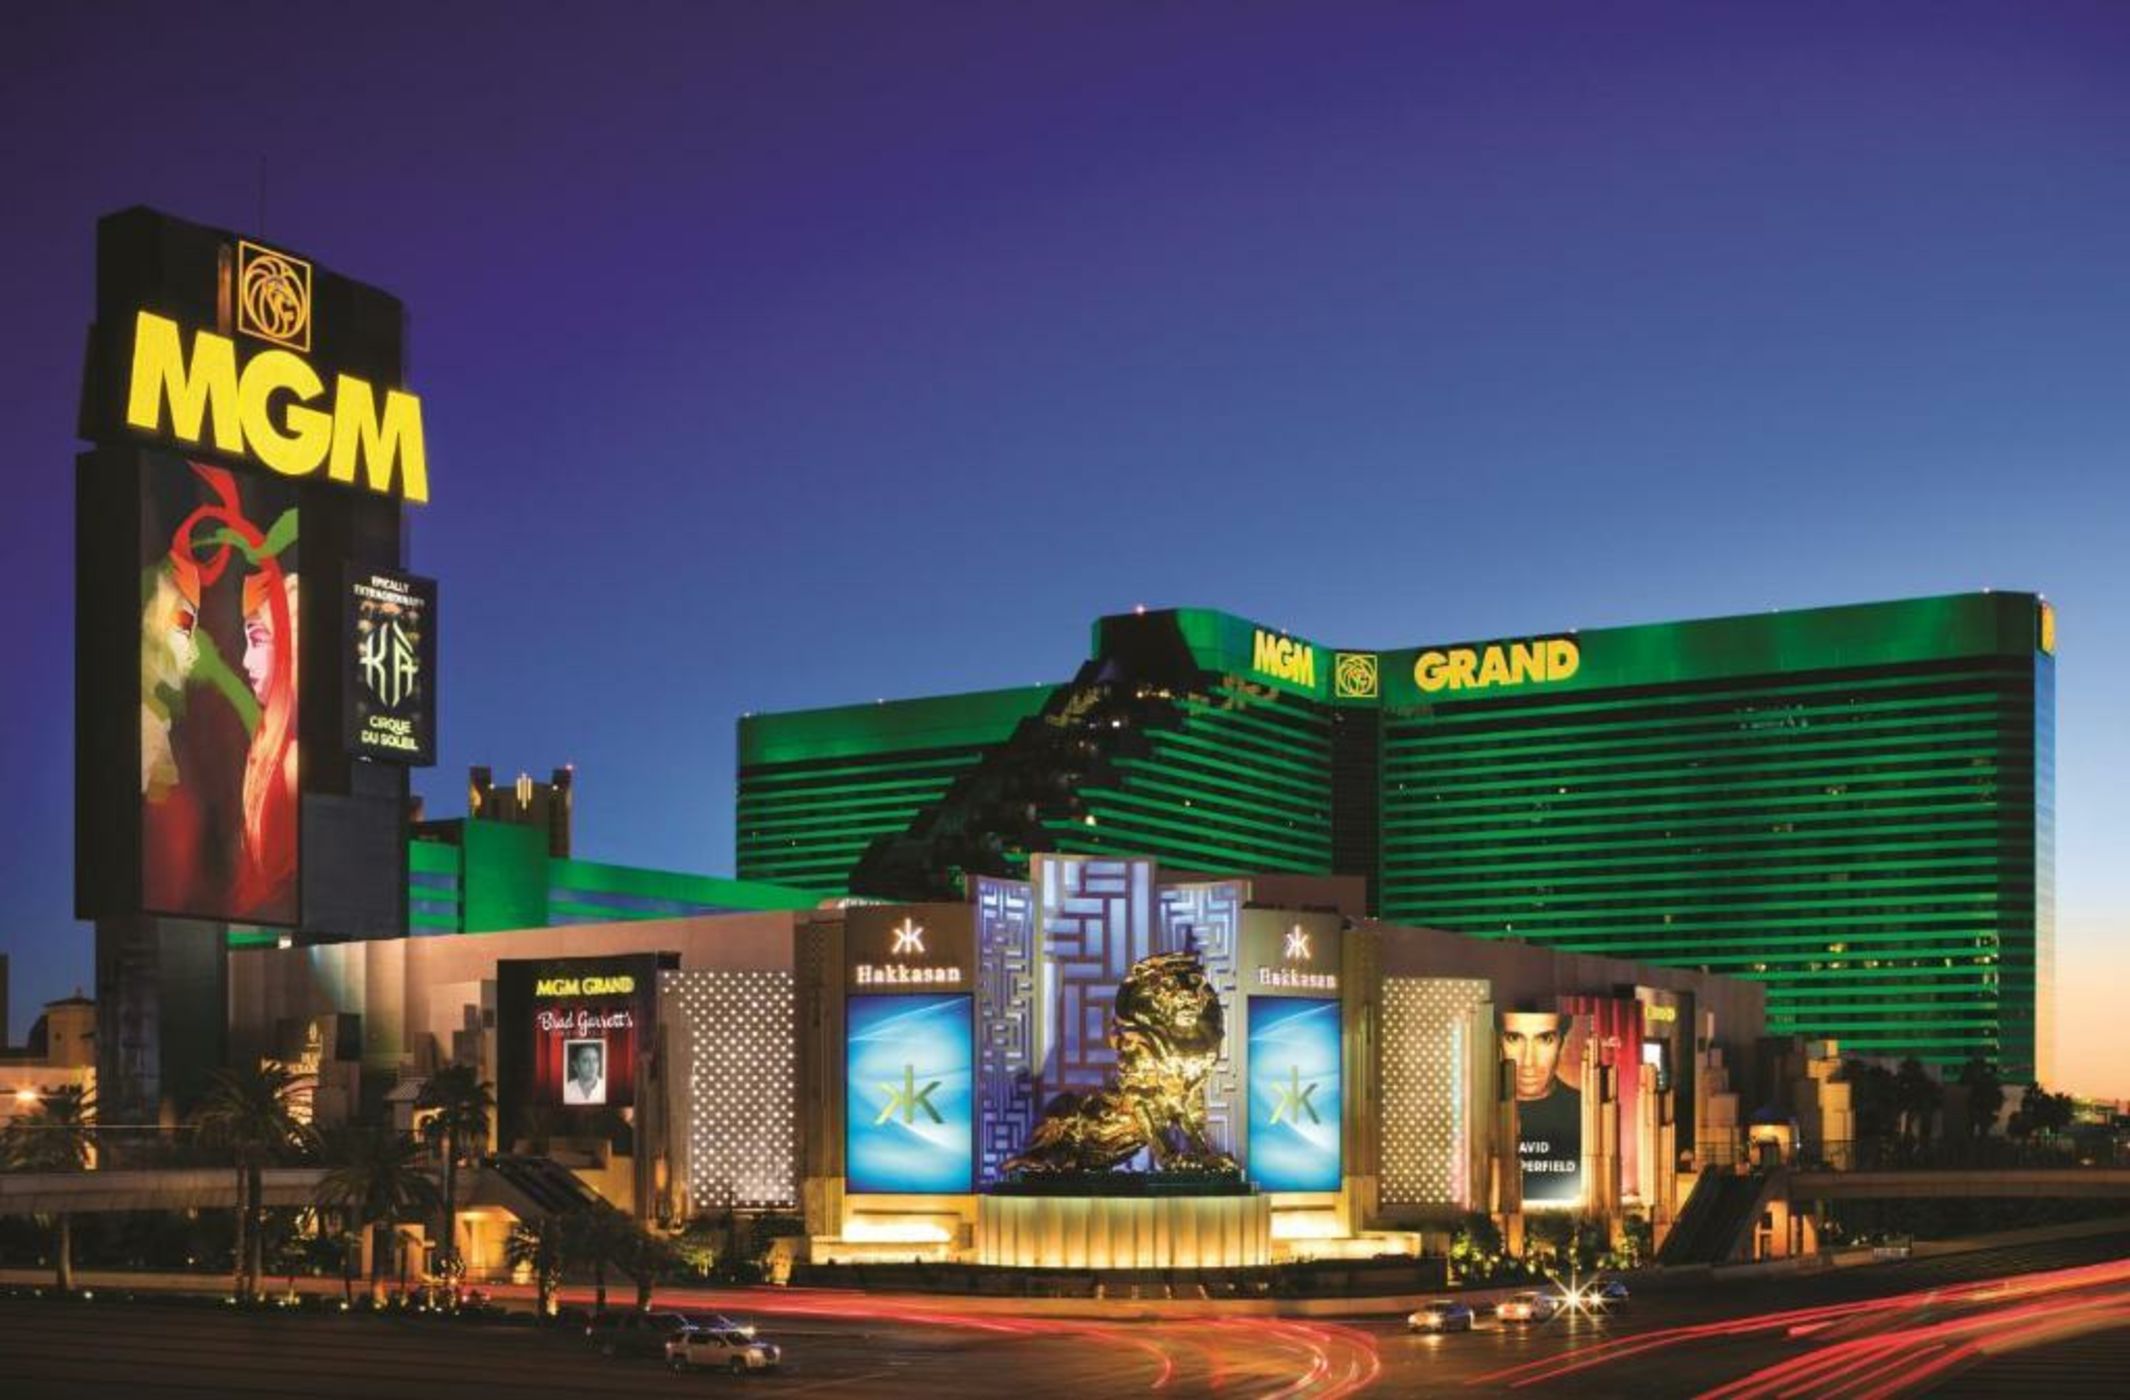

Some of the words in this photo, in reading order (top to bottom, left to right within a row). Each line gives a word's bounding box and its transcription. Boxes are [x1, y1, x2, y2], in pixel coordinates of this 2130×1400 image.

[127, 310, 429, 504] MGM
[1253, 629, 1316, 688] MGM
[1413, 639, 1580, 693] GRAND
[368, 715, 412, 735] CIRQUE
[535, 978, 581, 996] MGM
[582, 975, 635, 995] GRAND
[856, 964, 961, 984] Hakkasan
[537, 1010, 575, 1031] Brad
[577, 1009, 634, 1037] Garrett's
